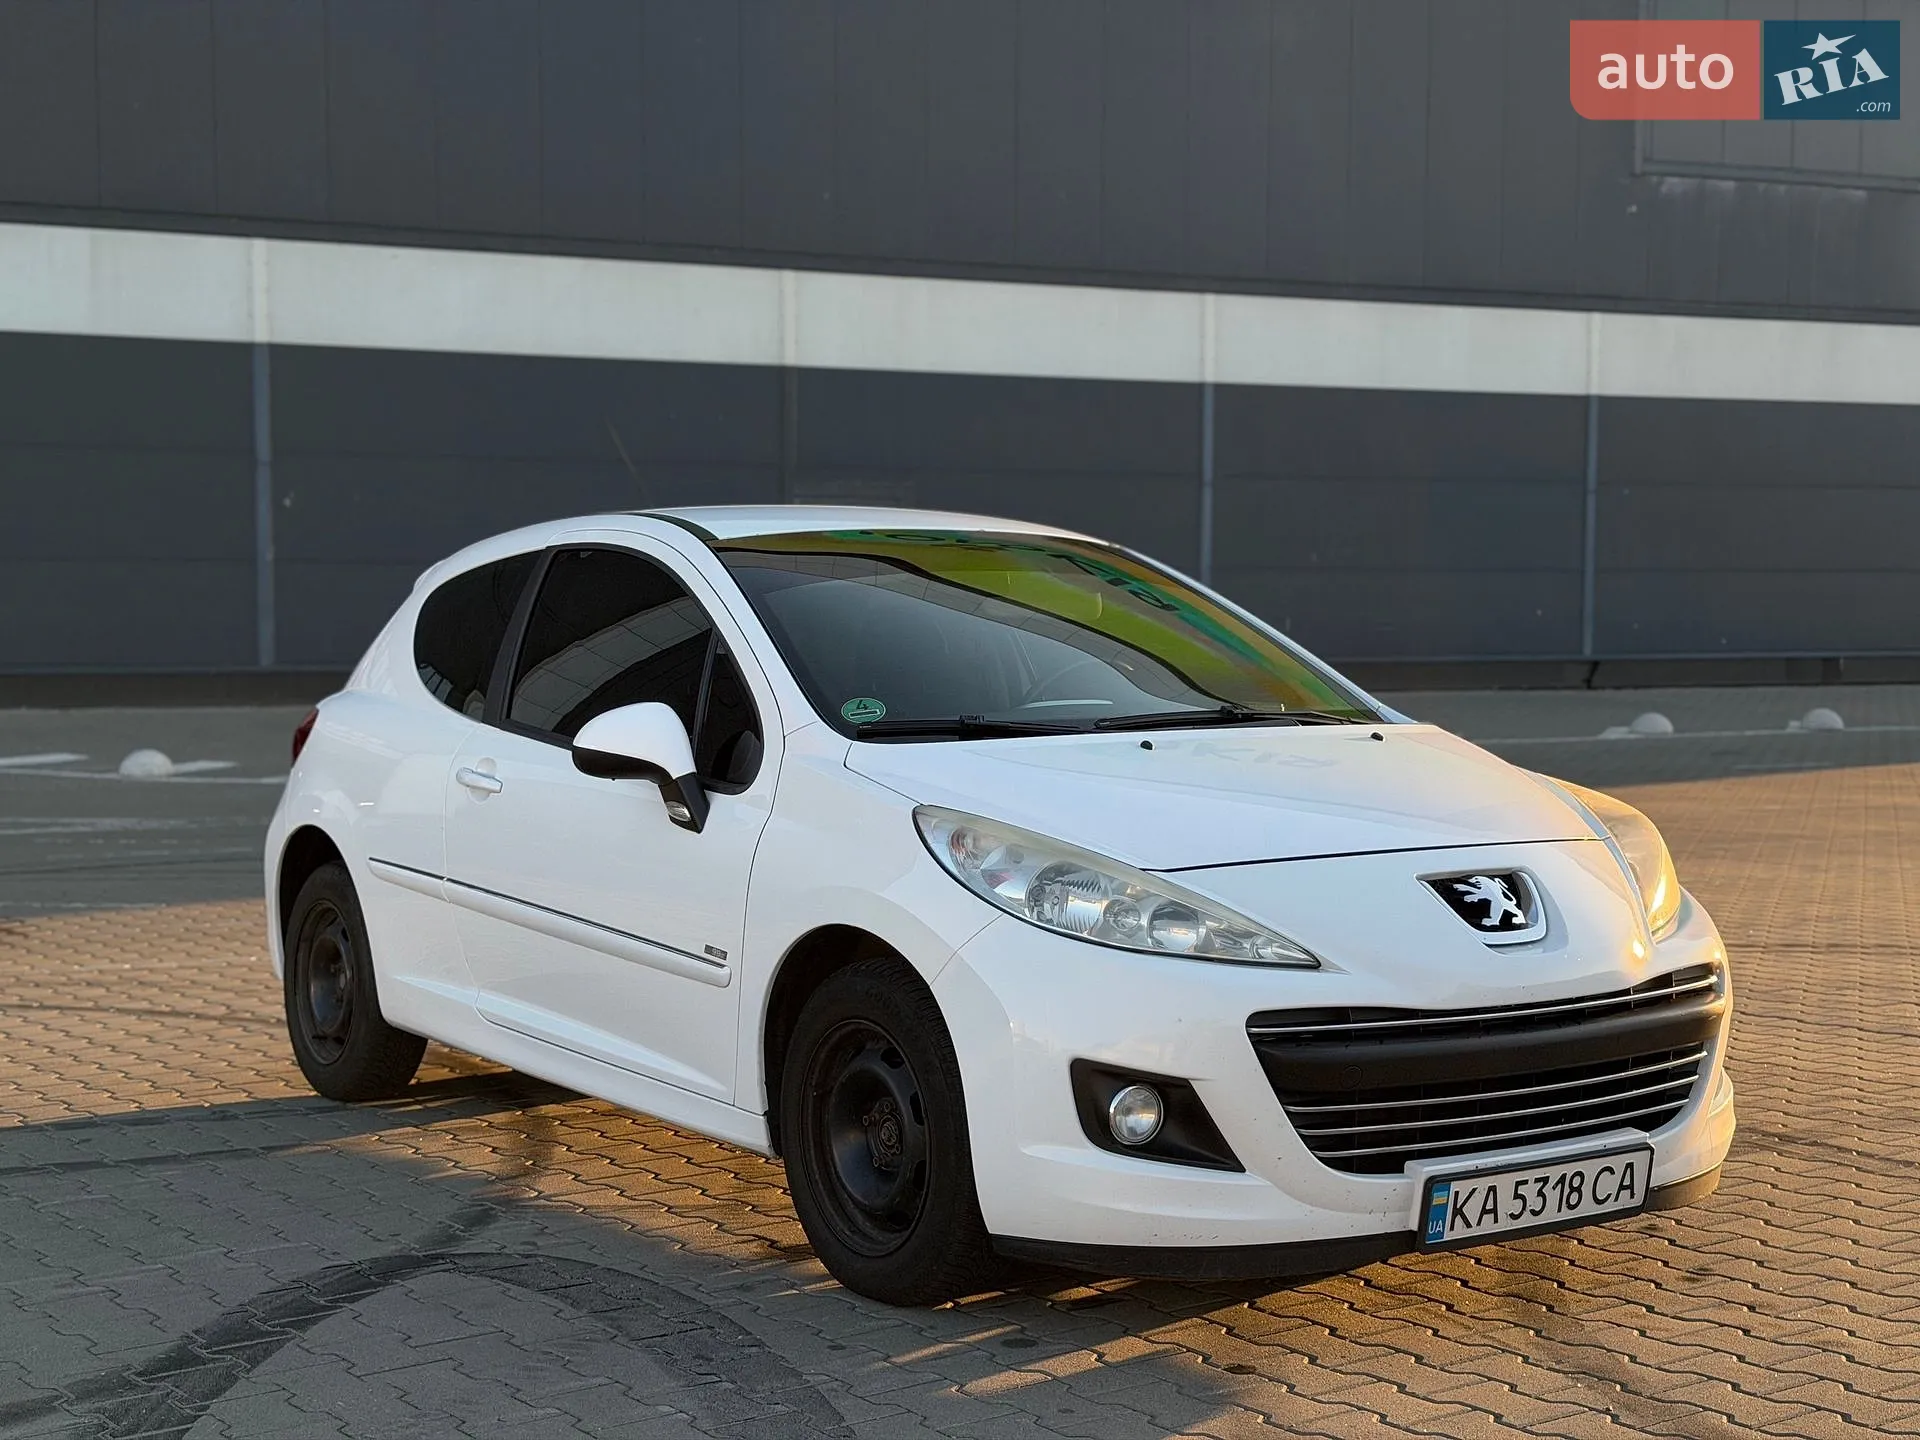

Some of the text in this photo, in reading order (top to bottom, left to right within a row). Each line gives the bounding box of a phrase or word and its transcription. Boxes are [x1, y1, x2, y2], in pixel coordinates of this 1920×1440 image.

[856, 699, 869, 710] 4
[1449, 1161, 1636, 1231] KA 5318 CA
[1428, 1219, 1443, 1234] UA
